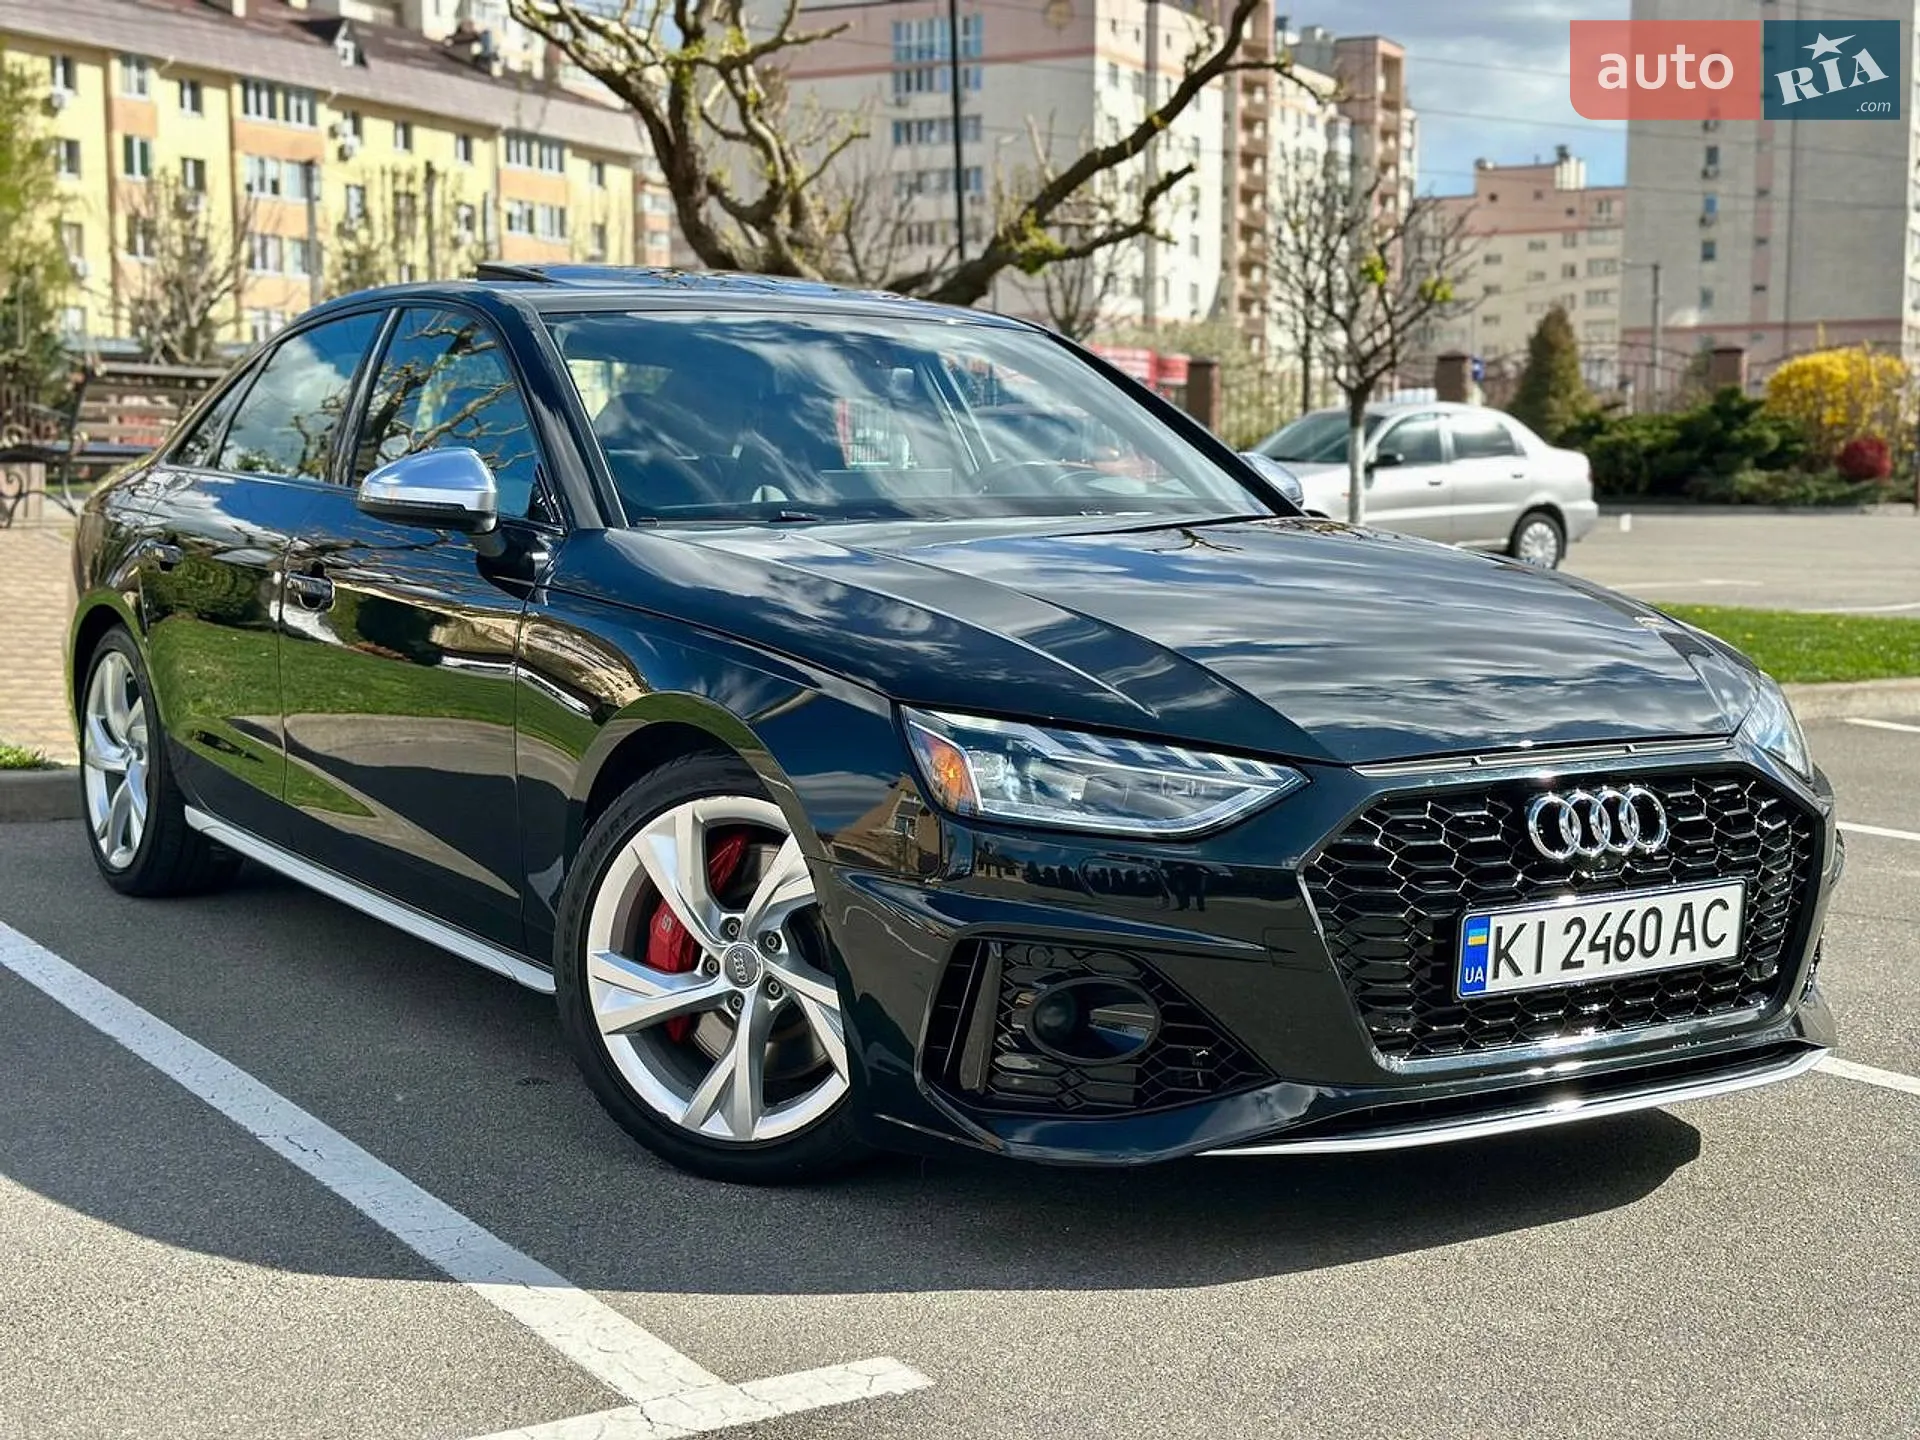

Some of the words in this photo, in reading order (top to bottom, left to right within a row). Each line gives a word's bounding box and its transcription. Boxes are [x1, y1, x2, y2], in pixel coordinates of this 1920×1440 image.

[1492, 921, 1546, 980] KI
[1561, 906, 1663, 970] 2460
[1670, 898, 1730, 955] AC
[1464, 965, 1485, 984] UA
